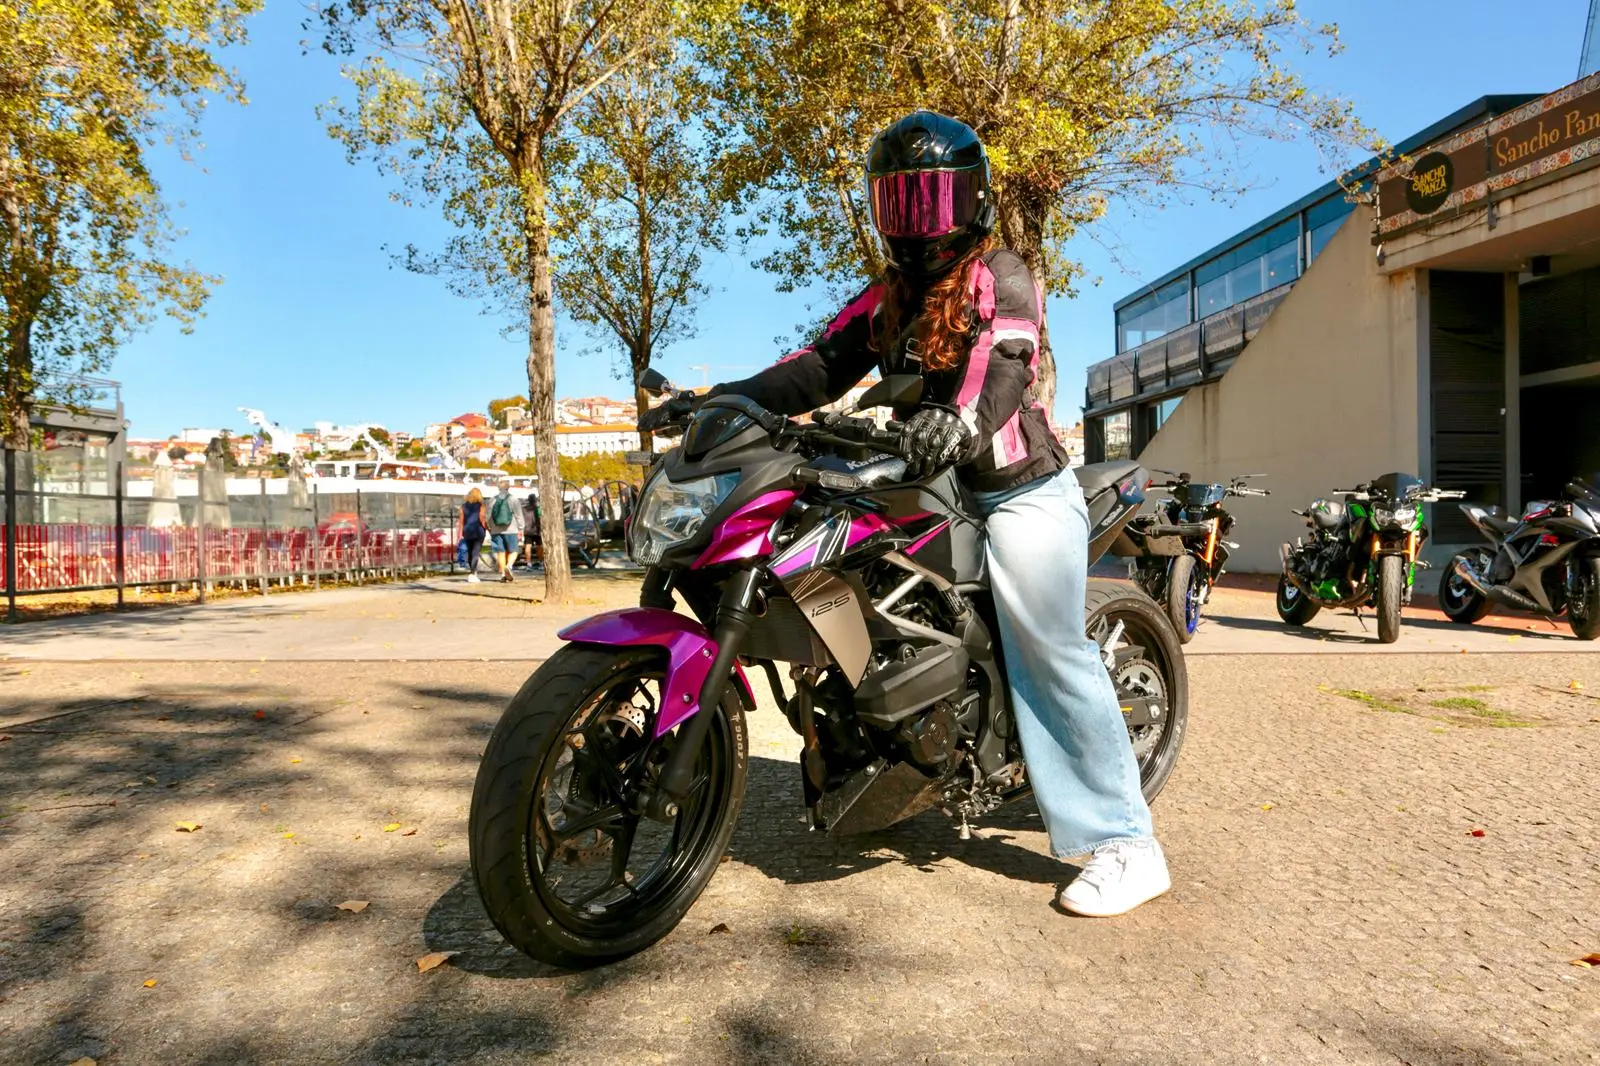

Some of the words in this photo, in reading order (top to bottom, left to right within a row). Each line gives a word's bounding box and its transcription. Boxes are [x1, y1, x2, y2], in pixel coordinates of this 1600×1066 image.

[1496, 120, 1560, 167] Sancho
[1564, 109, 1600, 140] Pan
[1412, 165, 1446, 192] SANCHO
[1419, 177, 1447, 198] PANZA
[811, 592, 850, 618] 125
